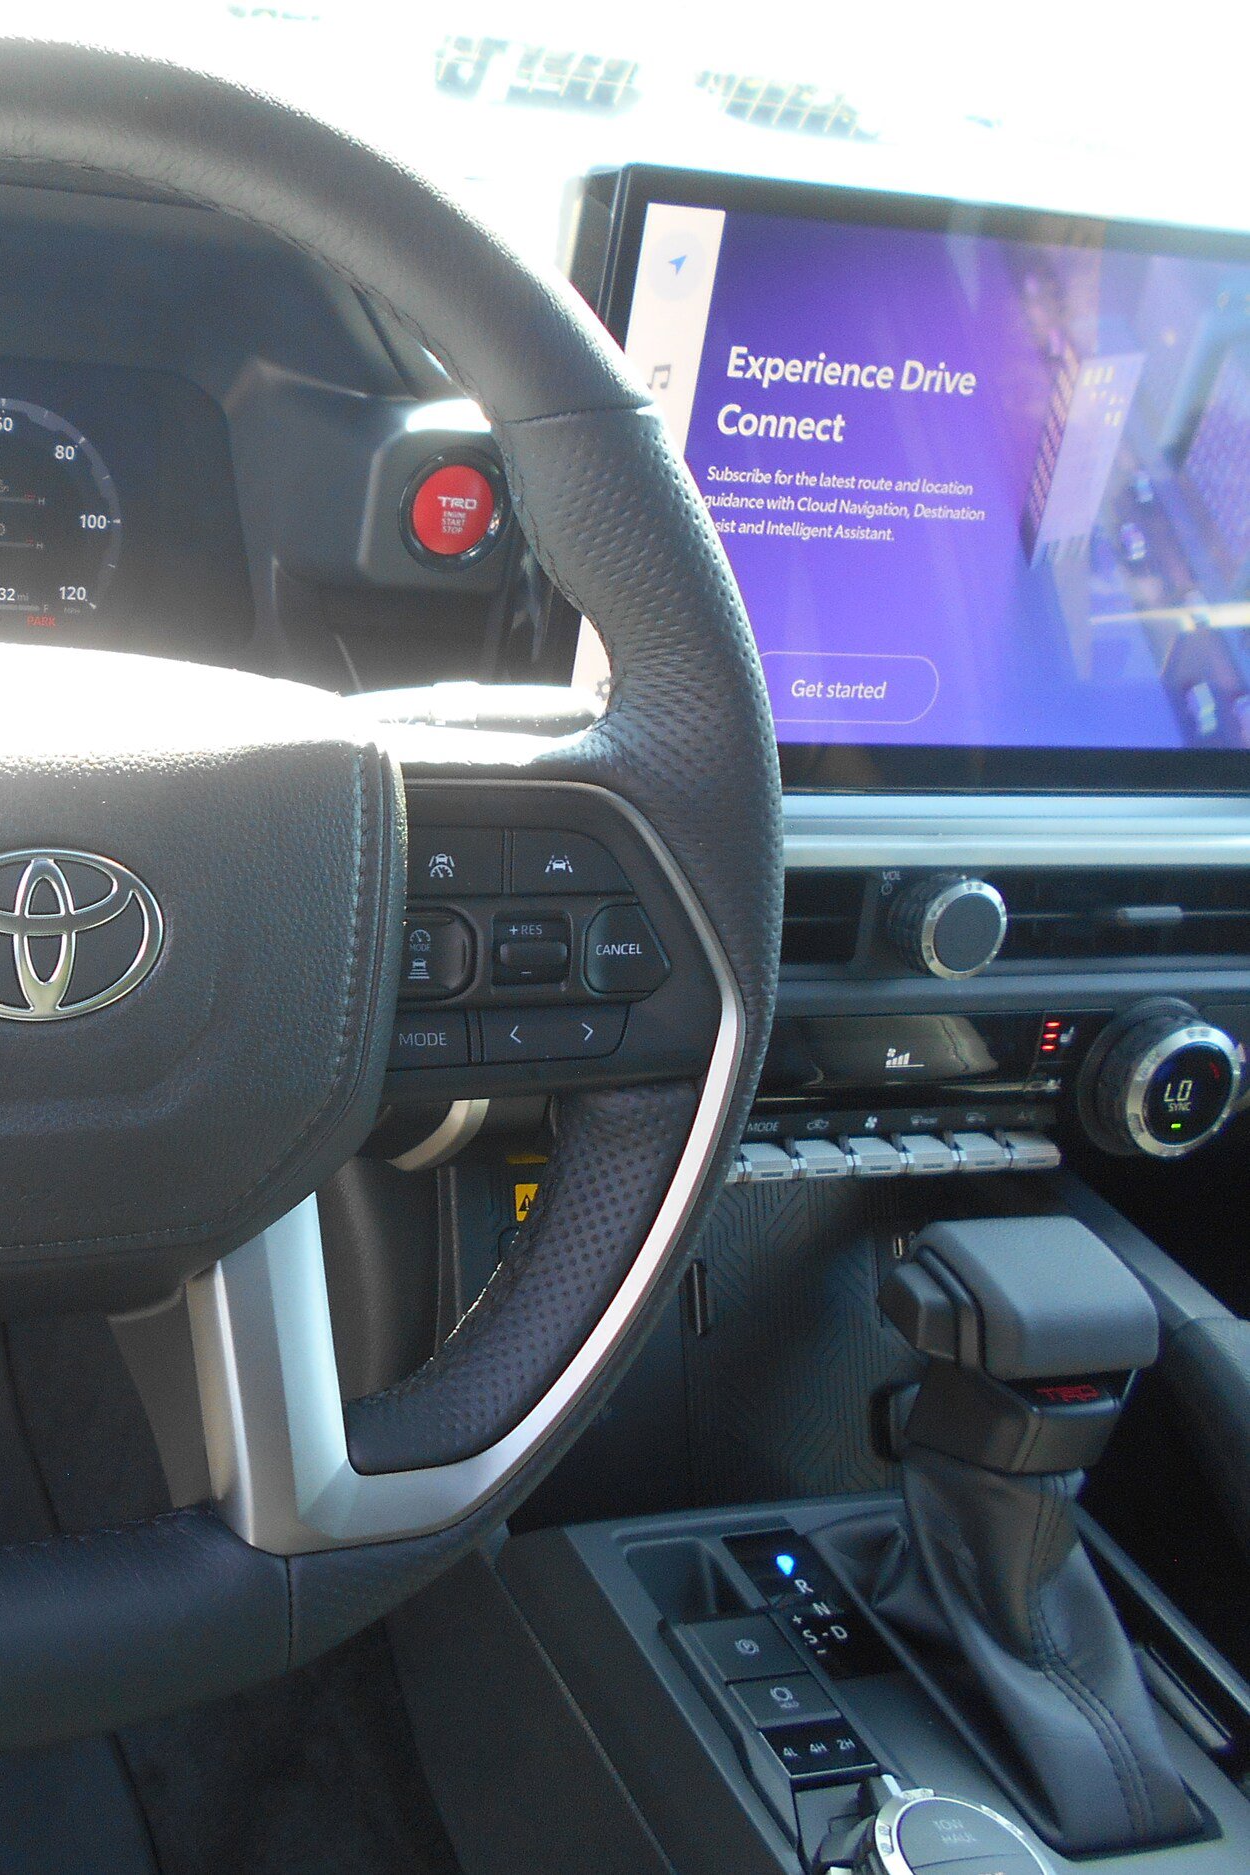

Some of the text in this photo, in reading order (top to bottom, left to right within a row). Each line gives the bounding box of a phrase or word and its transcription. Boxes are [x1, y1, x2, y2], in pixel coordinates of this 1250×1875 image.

[726, 346, 977, 395] Experience Drive
[716, 403, 846, 442] Connect
[54, 445, 75, 460] 80
[707, 466, 974, 495] Subscribe for the latest route and location
[437, 496, 478, 510] TRD
[703, 493, 986, 521] guidance with Cloud Navigation, Destination
[79, 514, 107, 529] 100
[442, 518, 466, 526] START
[442, 526, 464, 534] STOP
[738, 520, 765, 535] and
[766, 521, 832, 540] Intelligent
[834, 524, 894, 541] Assistant.
[59, 586, 86, 600] 120
[26, 614, 56, 626] PARK
[791, 680, 887, 699] Get started
[882, 870, 901, 881] VOL
[521, 924, 543, 935] RES
[595, 943, 643, 956] CANCEL
[399, 1032, 448, 1046] MODE
[1167, 1102, 1191, 1112] SYNC
[746, 1120, 779, 1132] MODE
[794, 1579, 813, 1594] R
[812, 1602, 831, 1615] N
[810, 1742, 828, 1753] 4H
[836, 1738, 855, 1751] 2H
